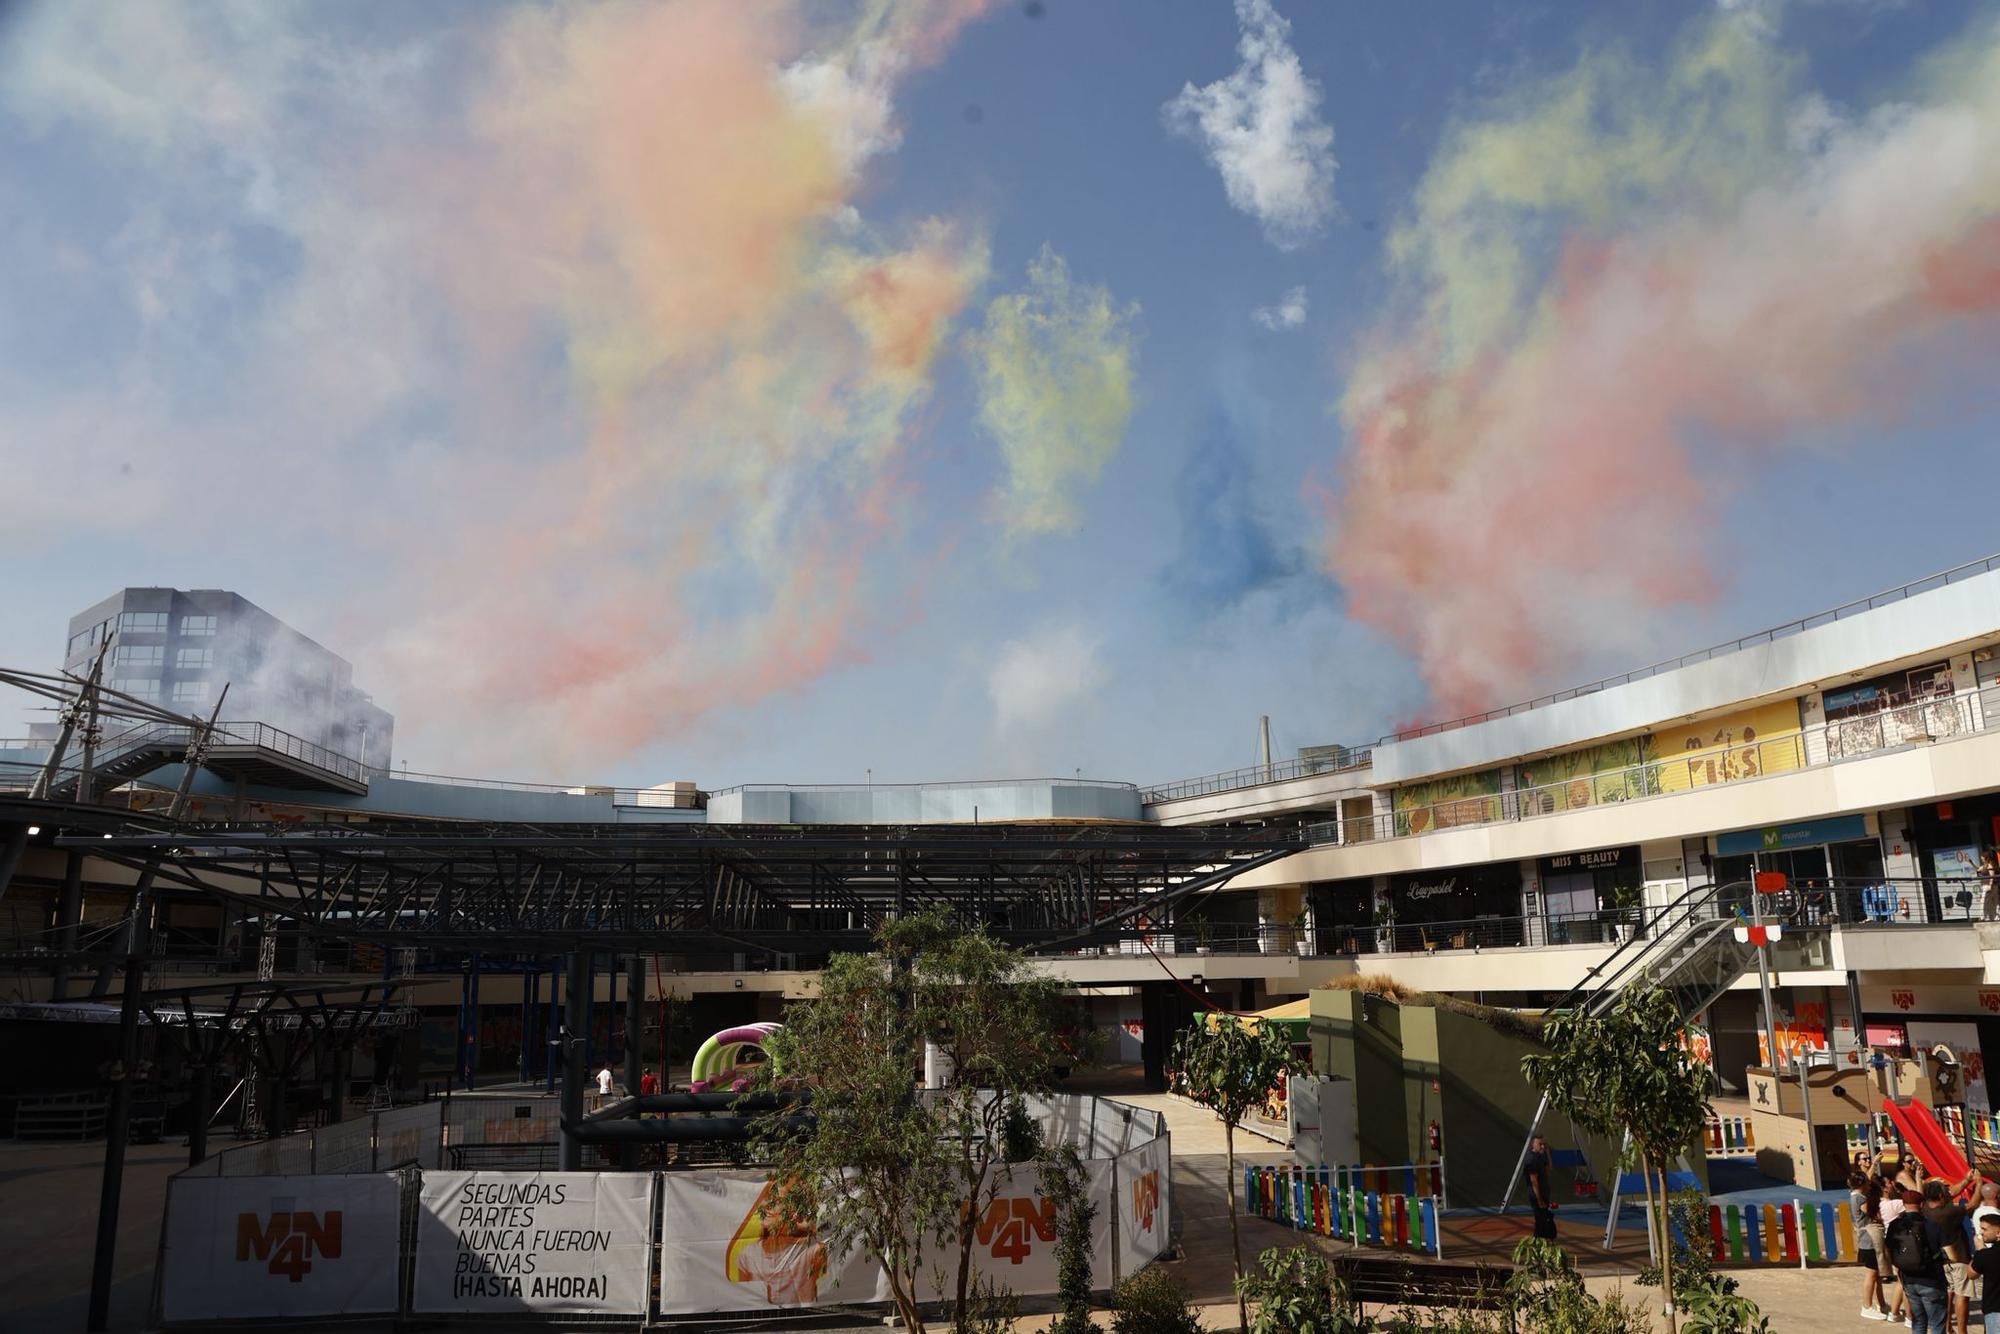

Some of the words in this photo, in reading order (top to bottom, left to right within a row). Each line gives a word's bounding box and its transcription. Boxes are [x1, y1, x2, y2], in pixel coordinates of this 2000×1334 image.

[1552, 856, 1572, 869] MISS
[1580, 850, 1620, 865] BEAUTY
[461, 1184, 566, 1205] SEGUNDAS
[458, 1207, 535, 1227] PARTES
[457, 1230, 525, 1250] NUNCA
[532, 1230, 611, 1251] FUERON
[455, 1253, 537, 1274] BUENAS
[453, 1274, 523, 1299] (HASTA
[531, 1274, 607, 1300] AHORA)
